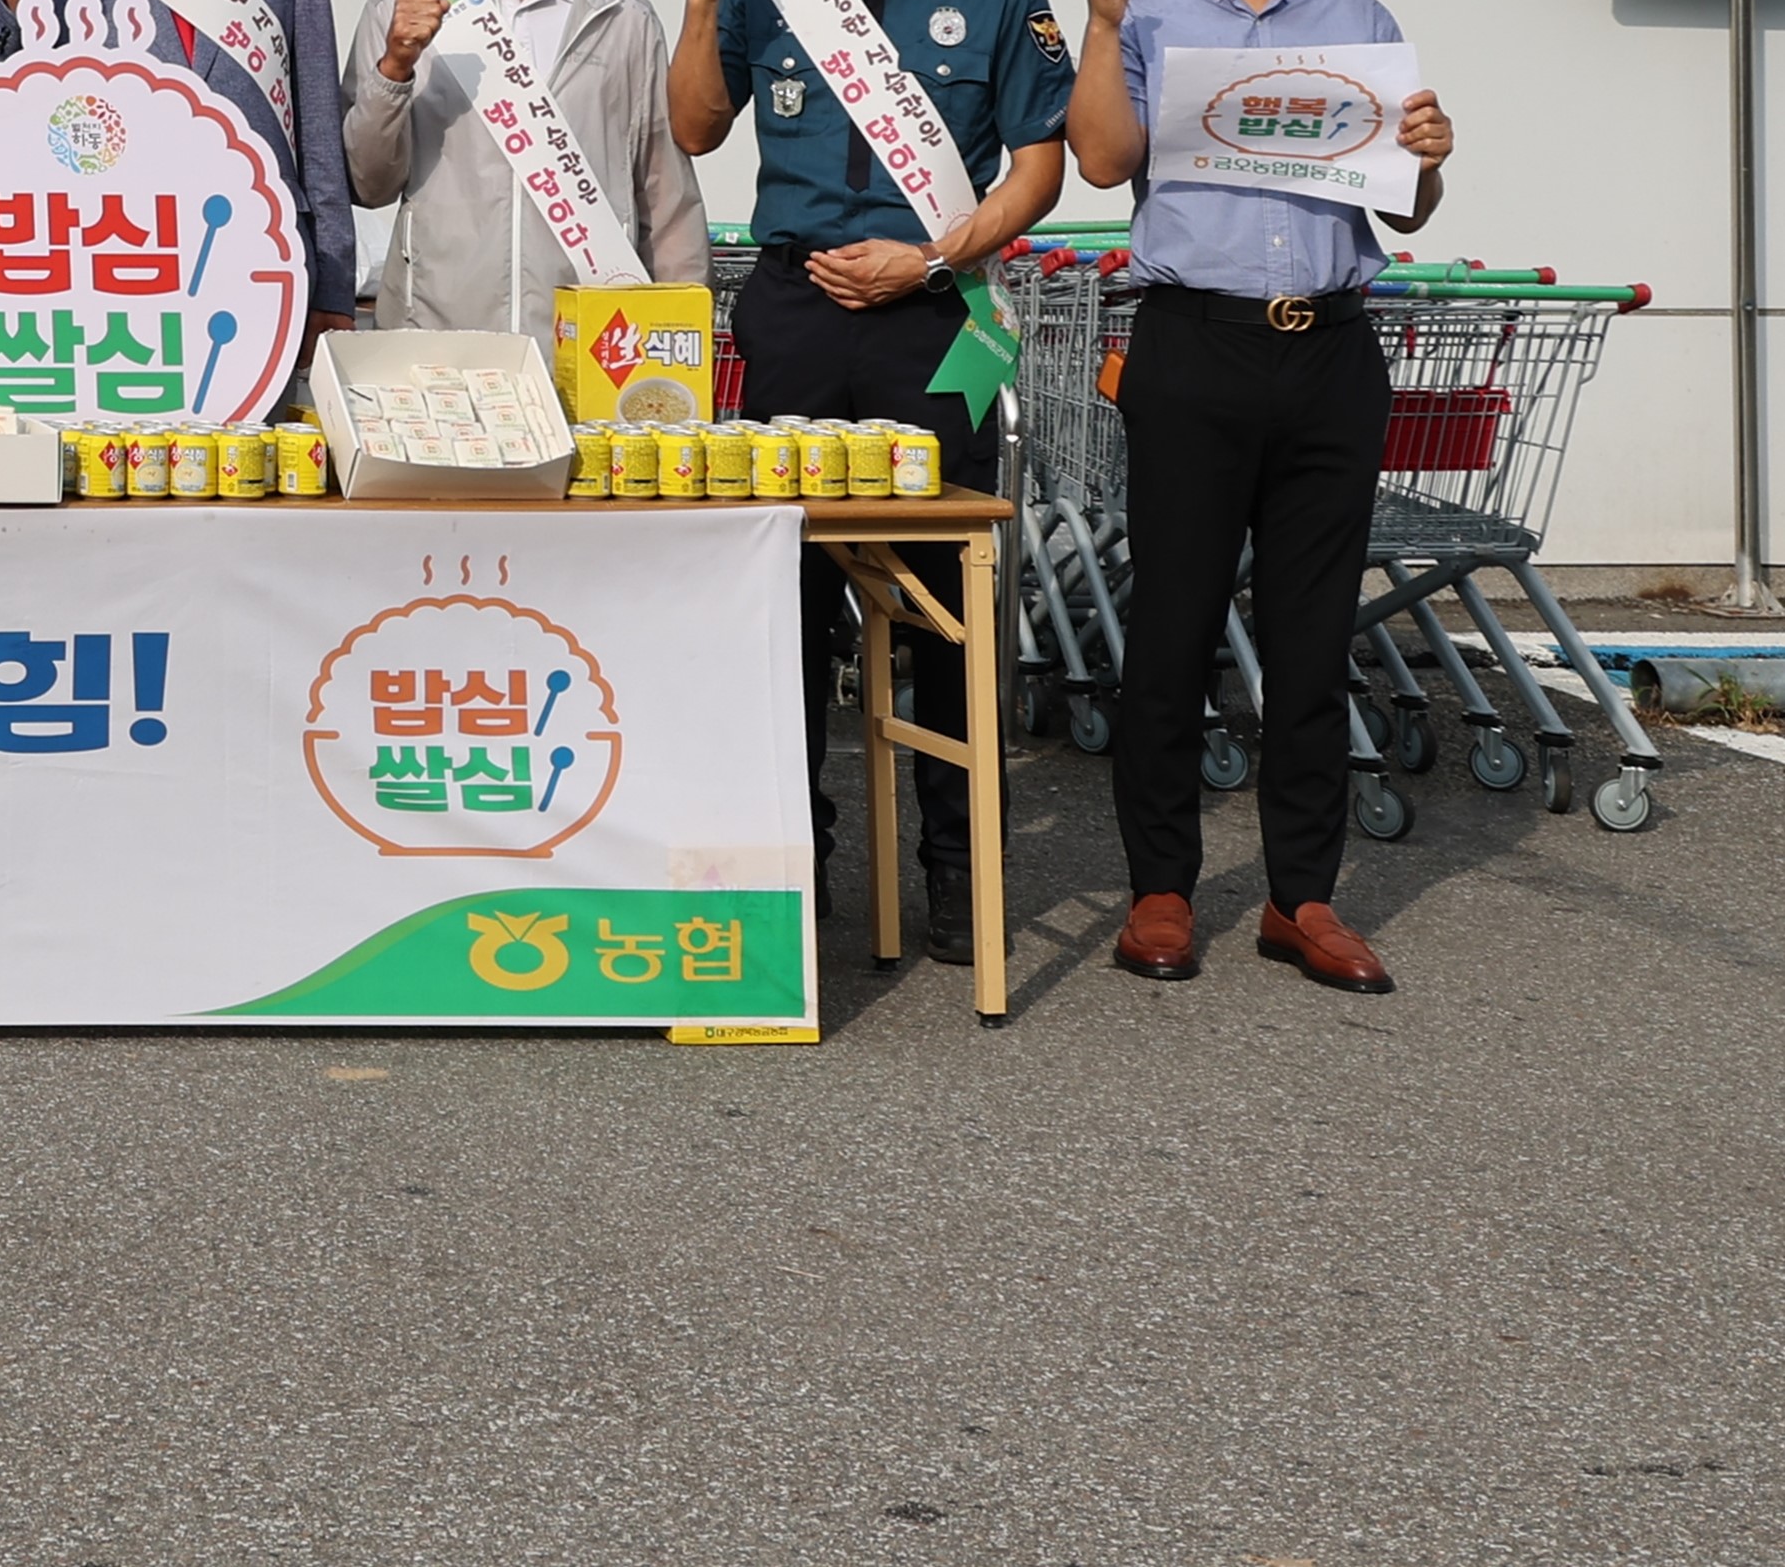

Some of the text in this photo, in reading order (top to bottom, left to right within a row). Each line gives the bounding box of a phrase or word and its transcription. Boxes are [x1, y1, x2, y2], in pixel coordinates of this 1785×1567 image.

[219, 20, 268, 73] 밥이
[471, 11, 534, 89] 건강한
[820, 50, 871, 106] 밥이
[483, 99, 533, 154] 밥이
[1237, 117, 1324, 139] 밥심
[1241, 95, 1328, 118] 행복
[70, 133, 102, 151] 하동
[1213, 156, 1367, 190] 금오농업협동조합
[369, 669, 531, 737] 밥심
[368, 745, 535, 813] 쌀심
[595, 916, 743, 983] 농협
